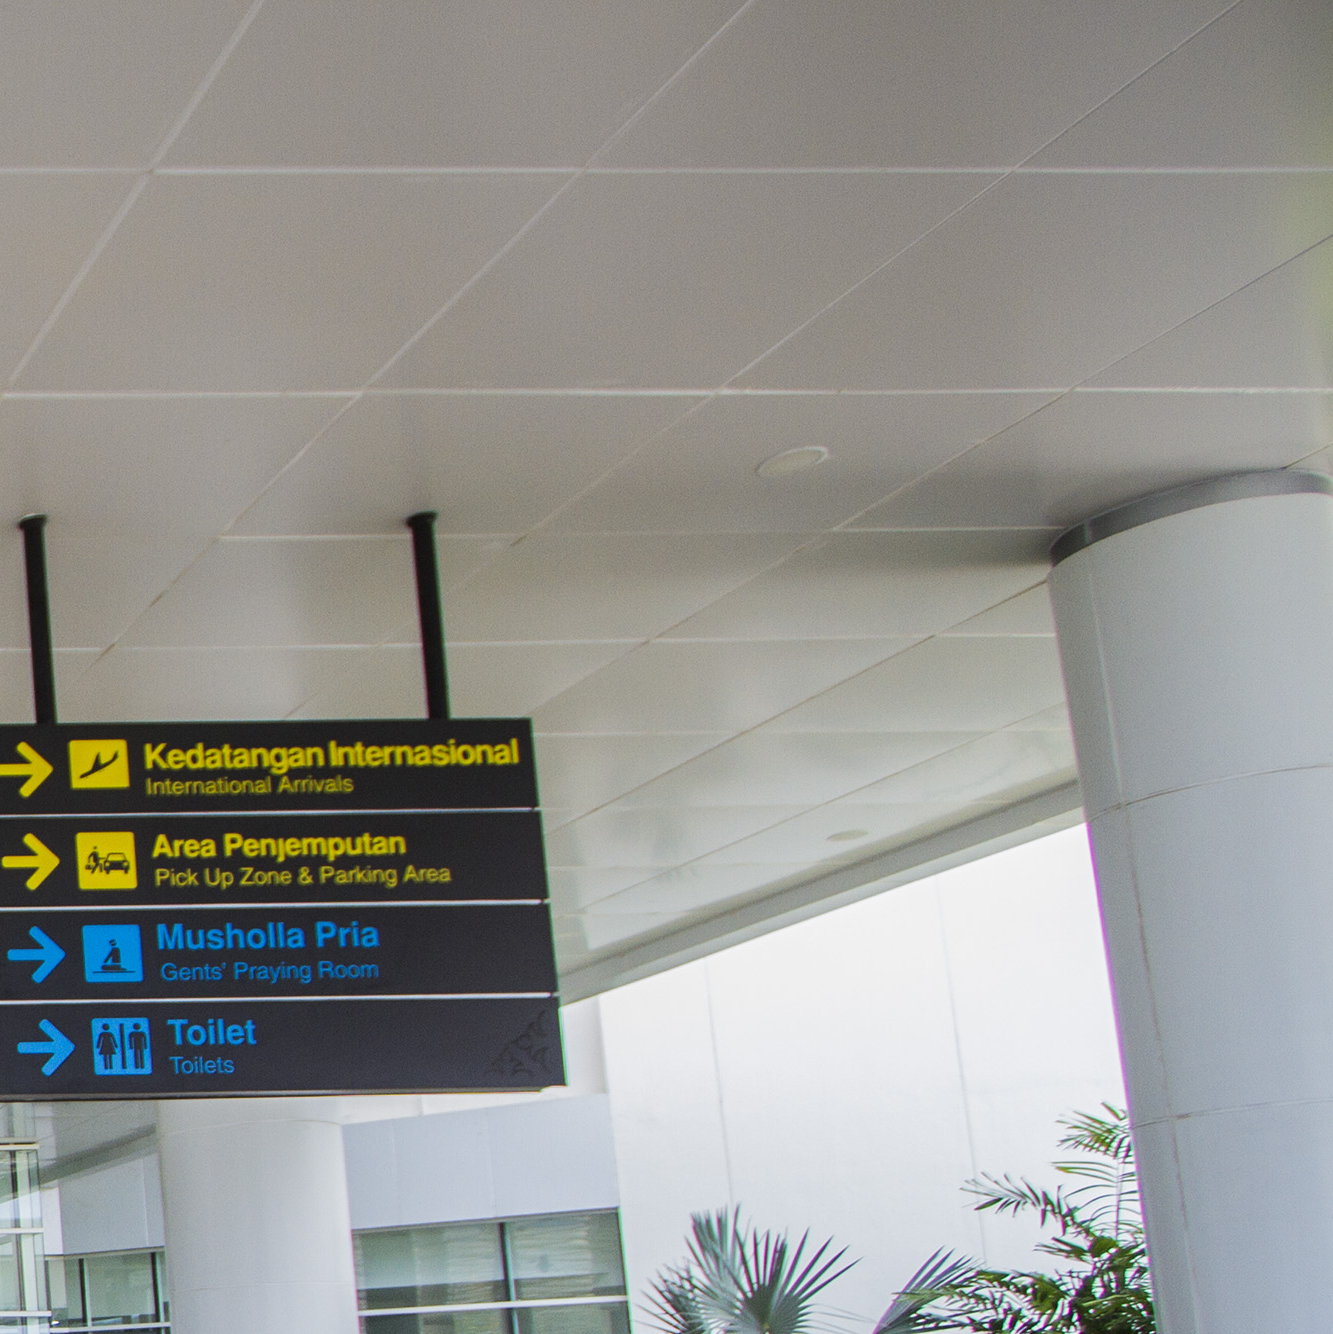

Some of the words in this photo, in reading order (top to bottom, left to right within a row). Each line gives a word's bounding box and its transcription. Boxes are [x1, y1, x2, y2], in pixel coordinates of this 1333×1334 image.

[144, 742, 325, 775] Kedatangan
[329, 737, 520, 767] Internasional
[145, 776, 272, 795] International
[277, 774, 355, 793] Arrivals
[152, 834, 217, 858] Area
[223, 832, 407, 863] Penjemputan
[154, 868, 199, 887] Pick
[204, 867, 235, 889] Up
[239, 866, 293, 886] Zone
[297, 865, 314, 885] &
[319, 865, 399, 888] Parking
[403, 864, 453, 883] Area
[156, 922, 306, 951] Musholla
[315, 920, 381, 949] Pria
[160, 961, 227, 982] Gents'
[233, 961, 312, 985] Praying
[318, 960, 380, 980] Room
[167, 1018, 258, 1047] Toilet
[168, 1055, 236, 1075] Toilets
